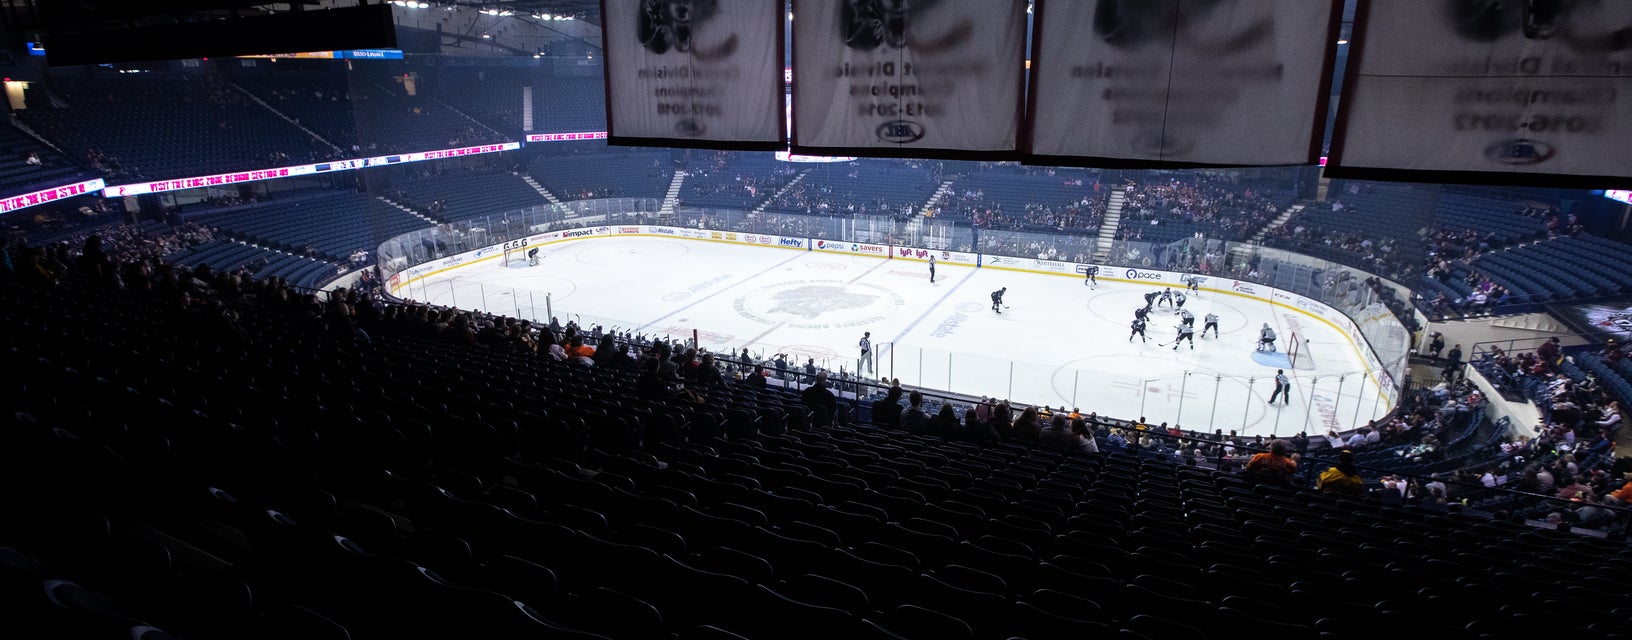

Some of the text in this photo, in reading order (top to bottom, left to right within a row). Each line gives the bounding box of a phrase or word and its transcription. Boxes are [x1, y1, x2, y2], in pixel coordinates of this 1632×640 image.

[150, 181, 169, 192] VISIT
[172, 180, 184, 189] THE
[187, 178, 204, 188] KIDS
[206, 175, 223, 185] ZONE
[225, 173, 249, 183] BEHIND
[251, 170, 277, 180] SECTION
[568, 229, 593, 238] impact
[503, 242, 510, 250] G
[780, 237, 802, 247] Hefty
[900, 248, 928, 258] lyft lyft
[1137, 271, 1161, 280] pace
